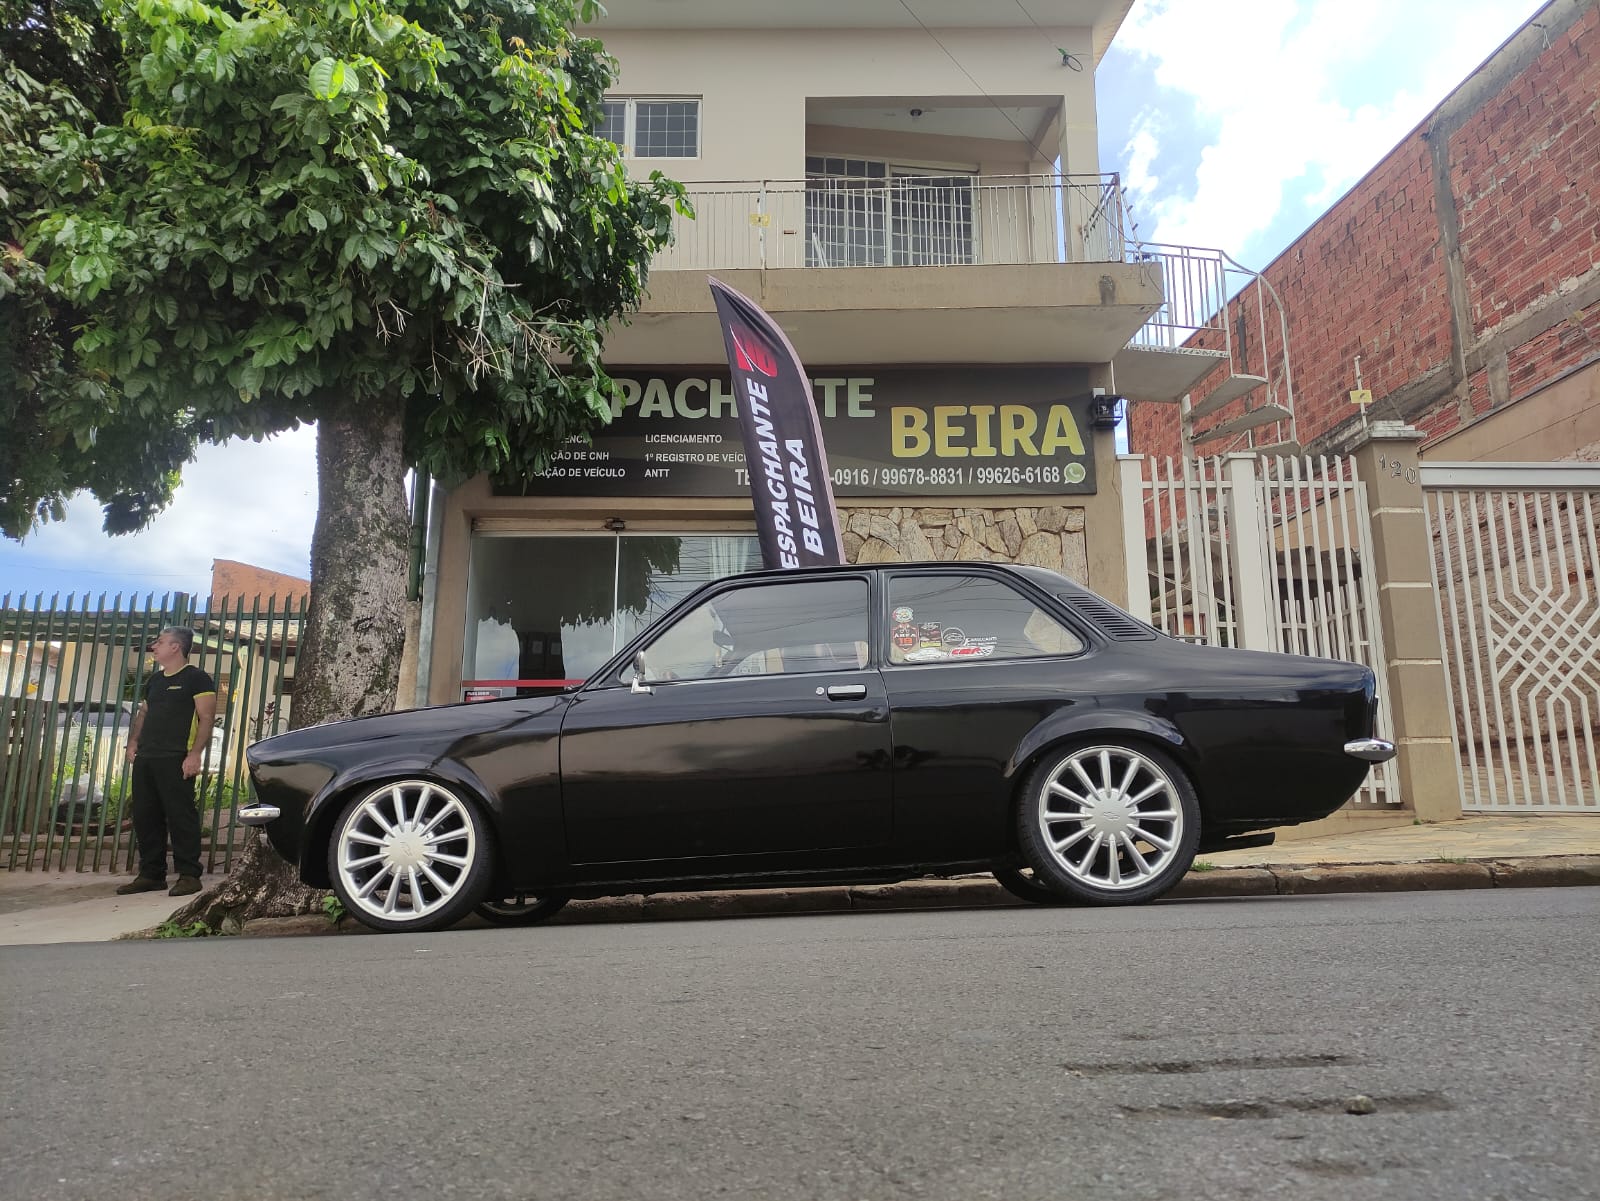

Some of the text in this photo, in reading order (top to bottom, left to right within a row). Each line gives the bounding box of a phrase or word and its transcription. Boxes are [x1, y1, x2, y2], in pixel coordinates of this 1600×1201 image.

[891, 404, 1086, 457] BEIRA
[645, 434, 722, 444] LICENCIAMENTO
[573, 452, 587, 460] DE
[589, 452, 609, 460] CNH
[655, 453, 704, 462] REGISTRO
[706, 453, 720, 462] DE
[568, 468, 581, 477] DE
[583, 466, 626, 477] VEÍCULO
[644, 468, 670, 478] ANTT
[734, 468, 751, 486] TE
[828, 468, 869, 485] -0916
[881, 467, 963, 485] 99678-8831
[977, 466, 1060, 485] 99626-6168
[746, 377, 799, 569] ESPACHANTE
[1379, 453, 1416, 485] 120
[785, 438, 824, 557] BEIRA
